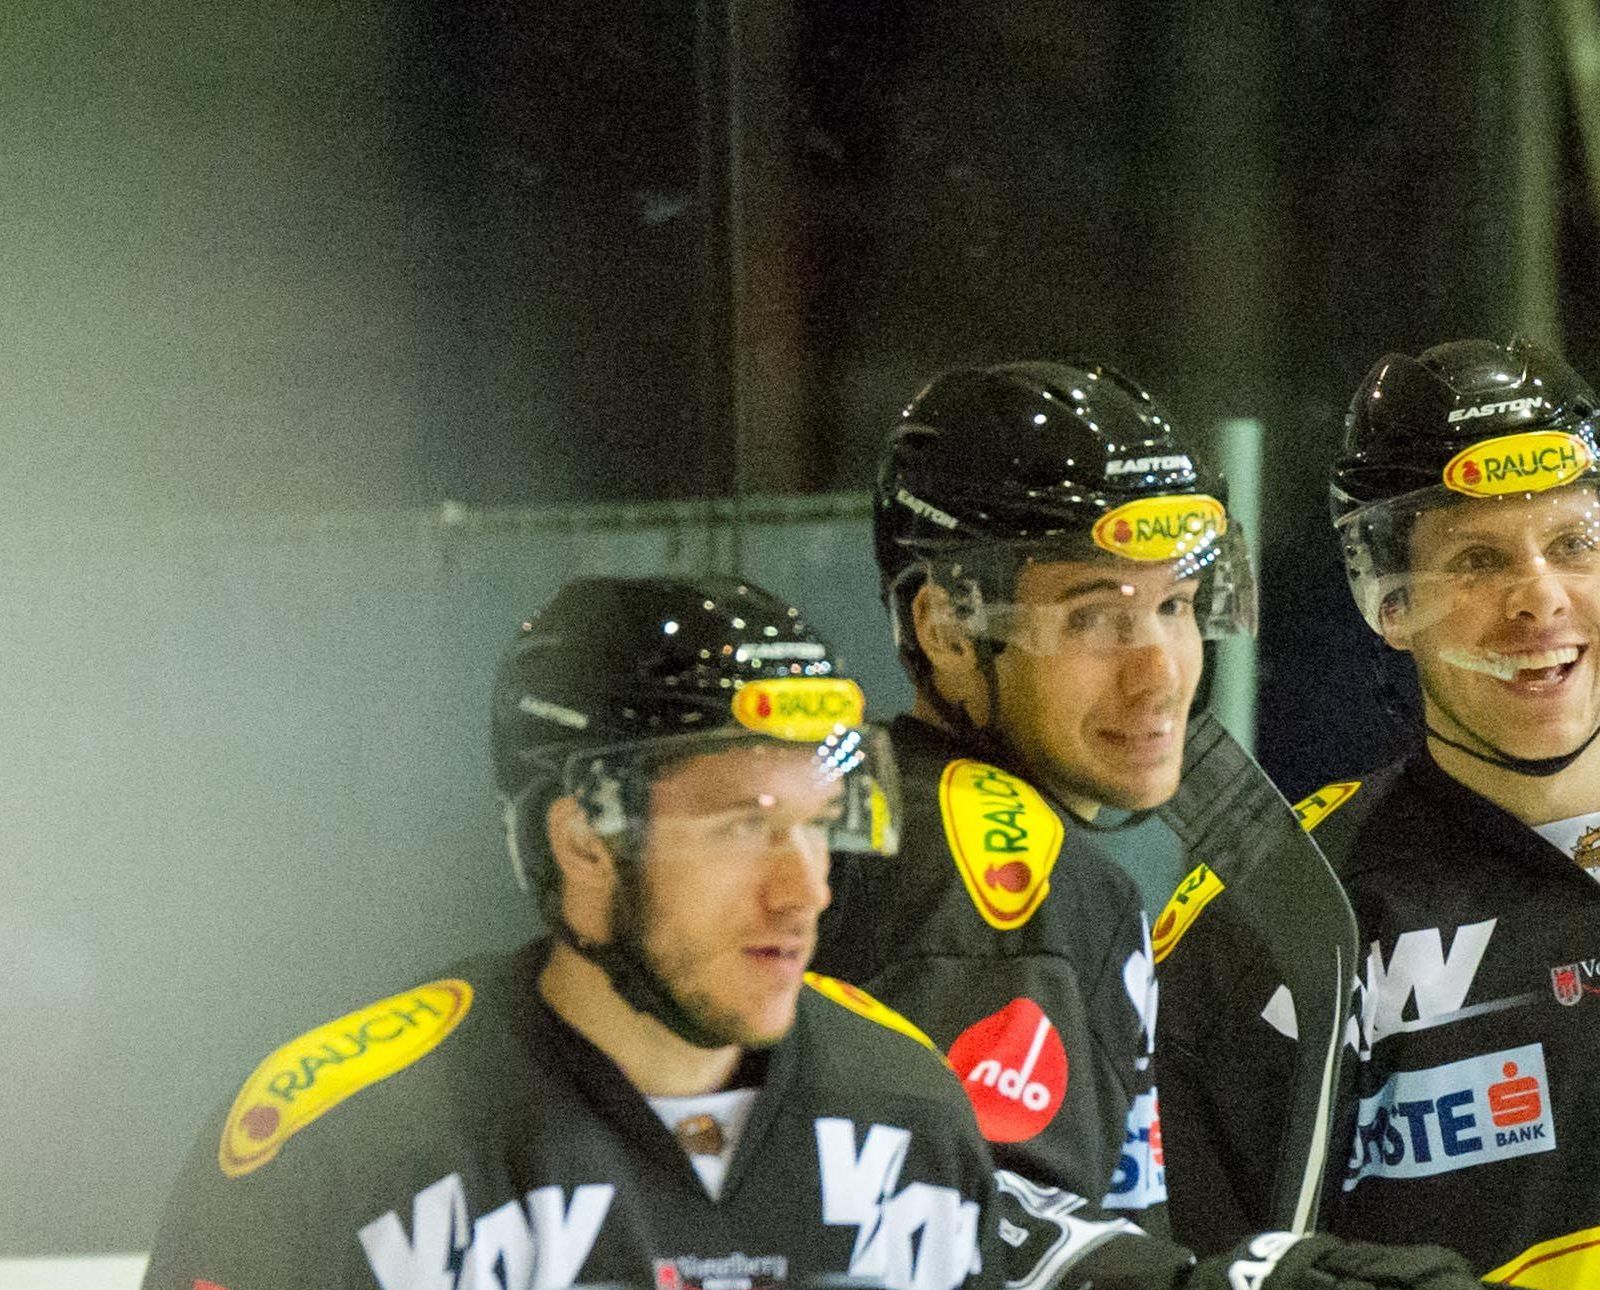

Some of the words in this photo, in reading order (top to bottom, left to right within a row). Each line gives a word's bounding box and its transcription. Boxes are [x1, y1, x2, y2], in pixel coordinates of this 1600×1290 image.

[1448, 397, 1543, 423] EASTON
[1484, 447, 1579, 484] RAUCH
[1135, 511, 1216, 543] RAUCH
[267, 996, 442, 1104] RAUCH
[1496, 1124, 1547, 1148] BANK
